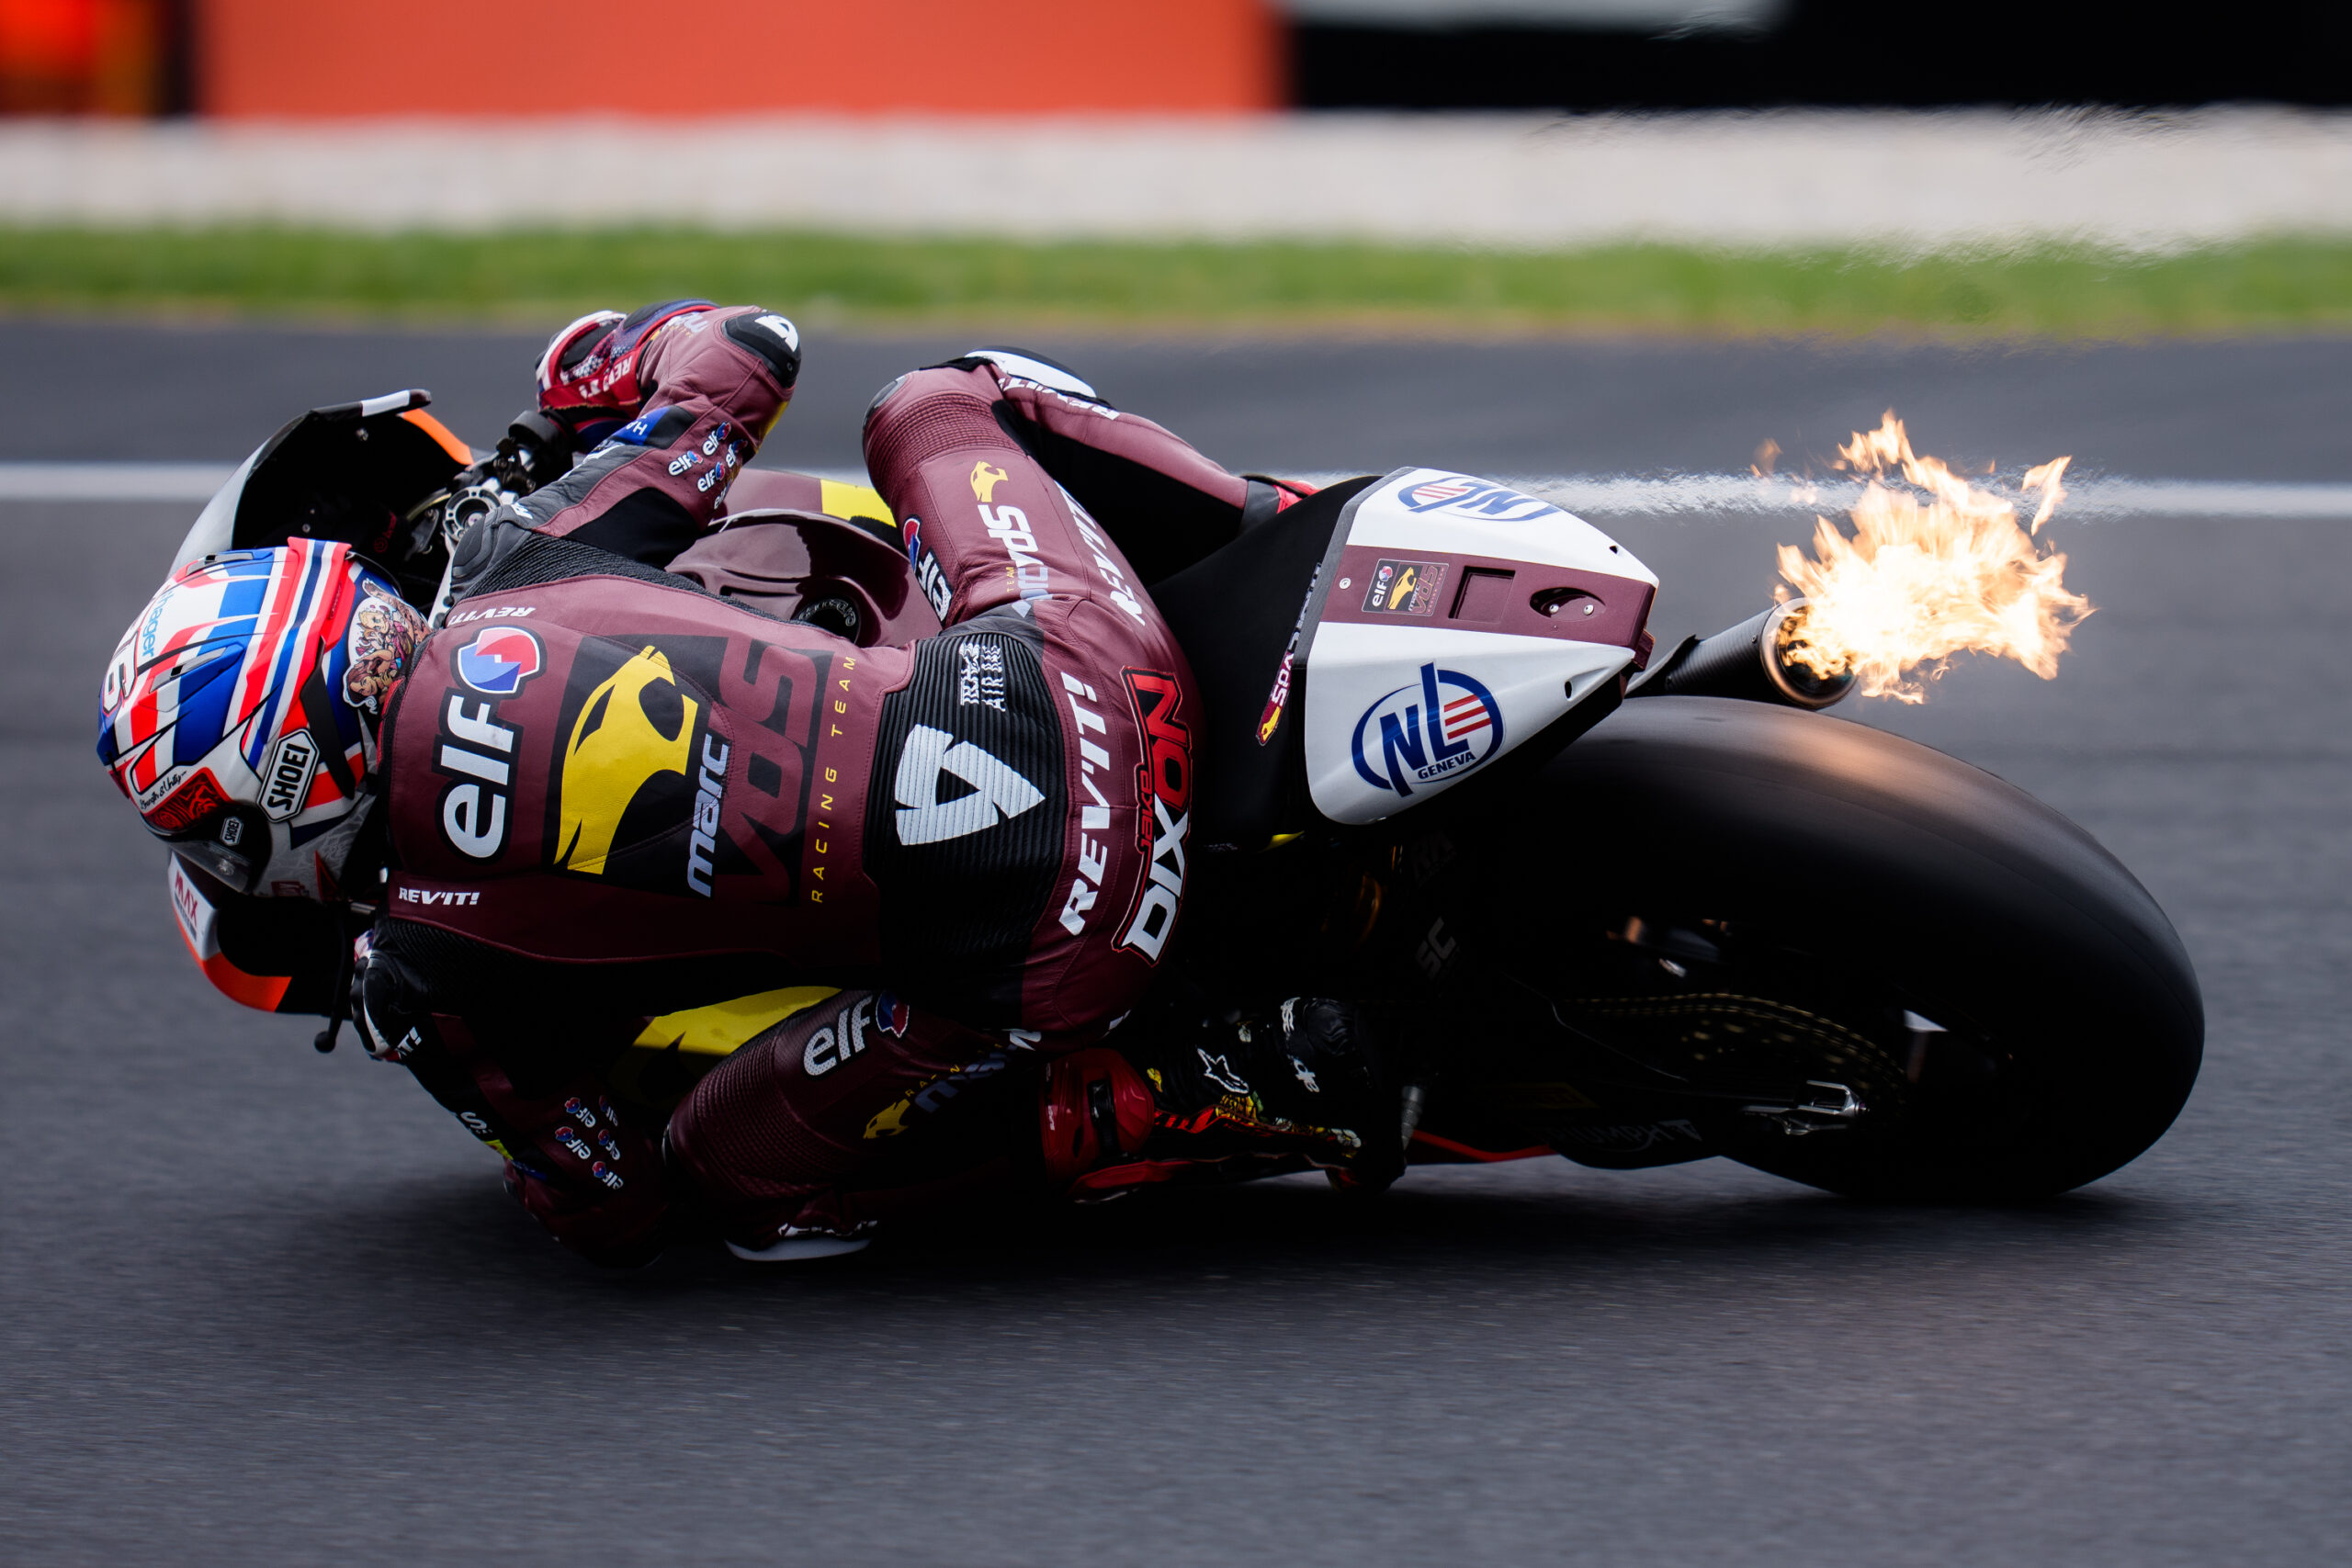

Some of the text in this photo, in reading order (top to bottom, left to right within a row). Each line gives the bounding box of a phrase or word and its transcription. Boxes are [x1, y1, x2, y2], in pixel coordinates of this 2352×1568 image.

[702, 430, 719, 456] elf
[668, 454, 693, 476] elf
[696, 468, 717, 492] elf
[1372, 580, 1387, 607] elf
[267, 742, 311, 812] SHOEI
[443, 695, 514, 860] elf
[1416, 750, 1477, 781] GENEVA
[811, 656, 857, 904] RACING TEAM
[687, 733, 732, 897] marc
[1058, 671, 1111, 936] REV'IT!
[1121, 672, 1193, 962] DIXON
[224, 819, 241, 843] SHOEI
[399, 887, 480, 906] REV'IT!
[803, 995, 876, 1077] elf
[575, 1106, 597, 1129] elf
[565, 1138, 592, 1160] elf
[602, 1170, 625, 1190] elf
